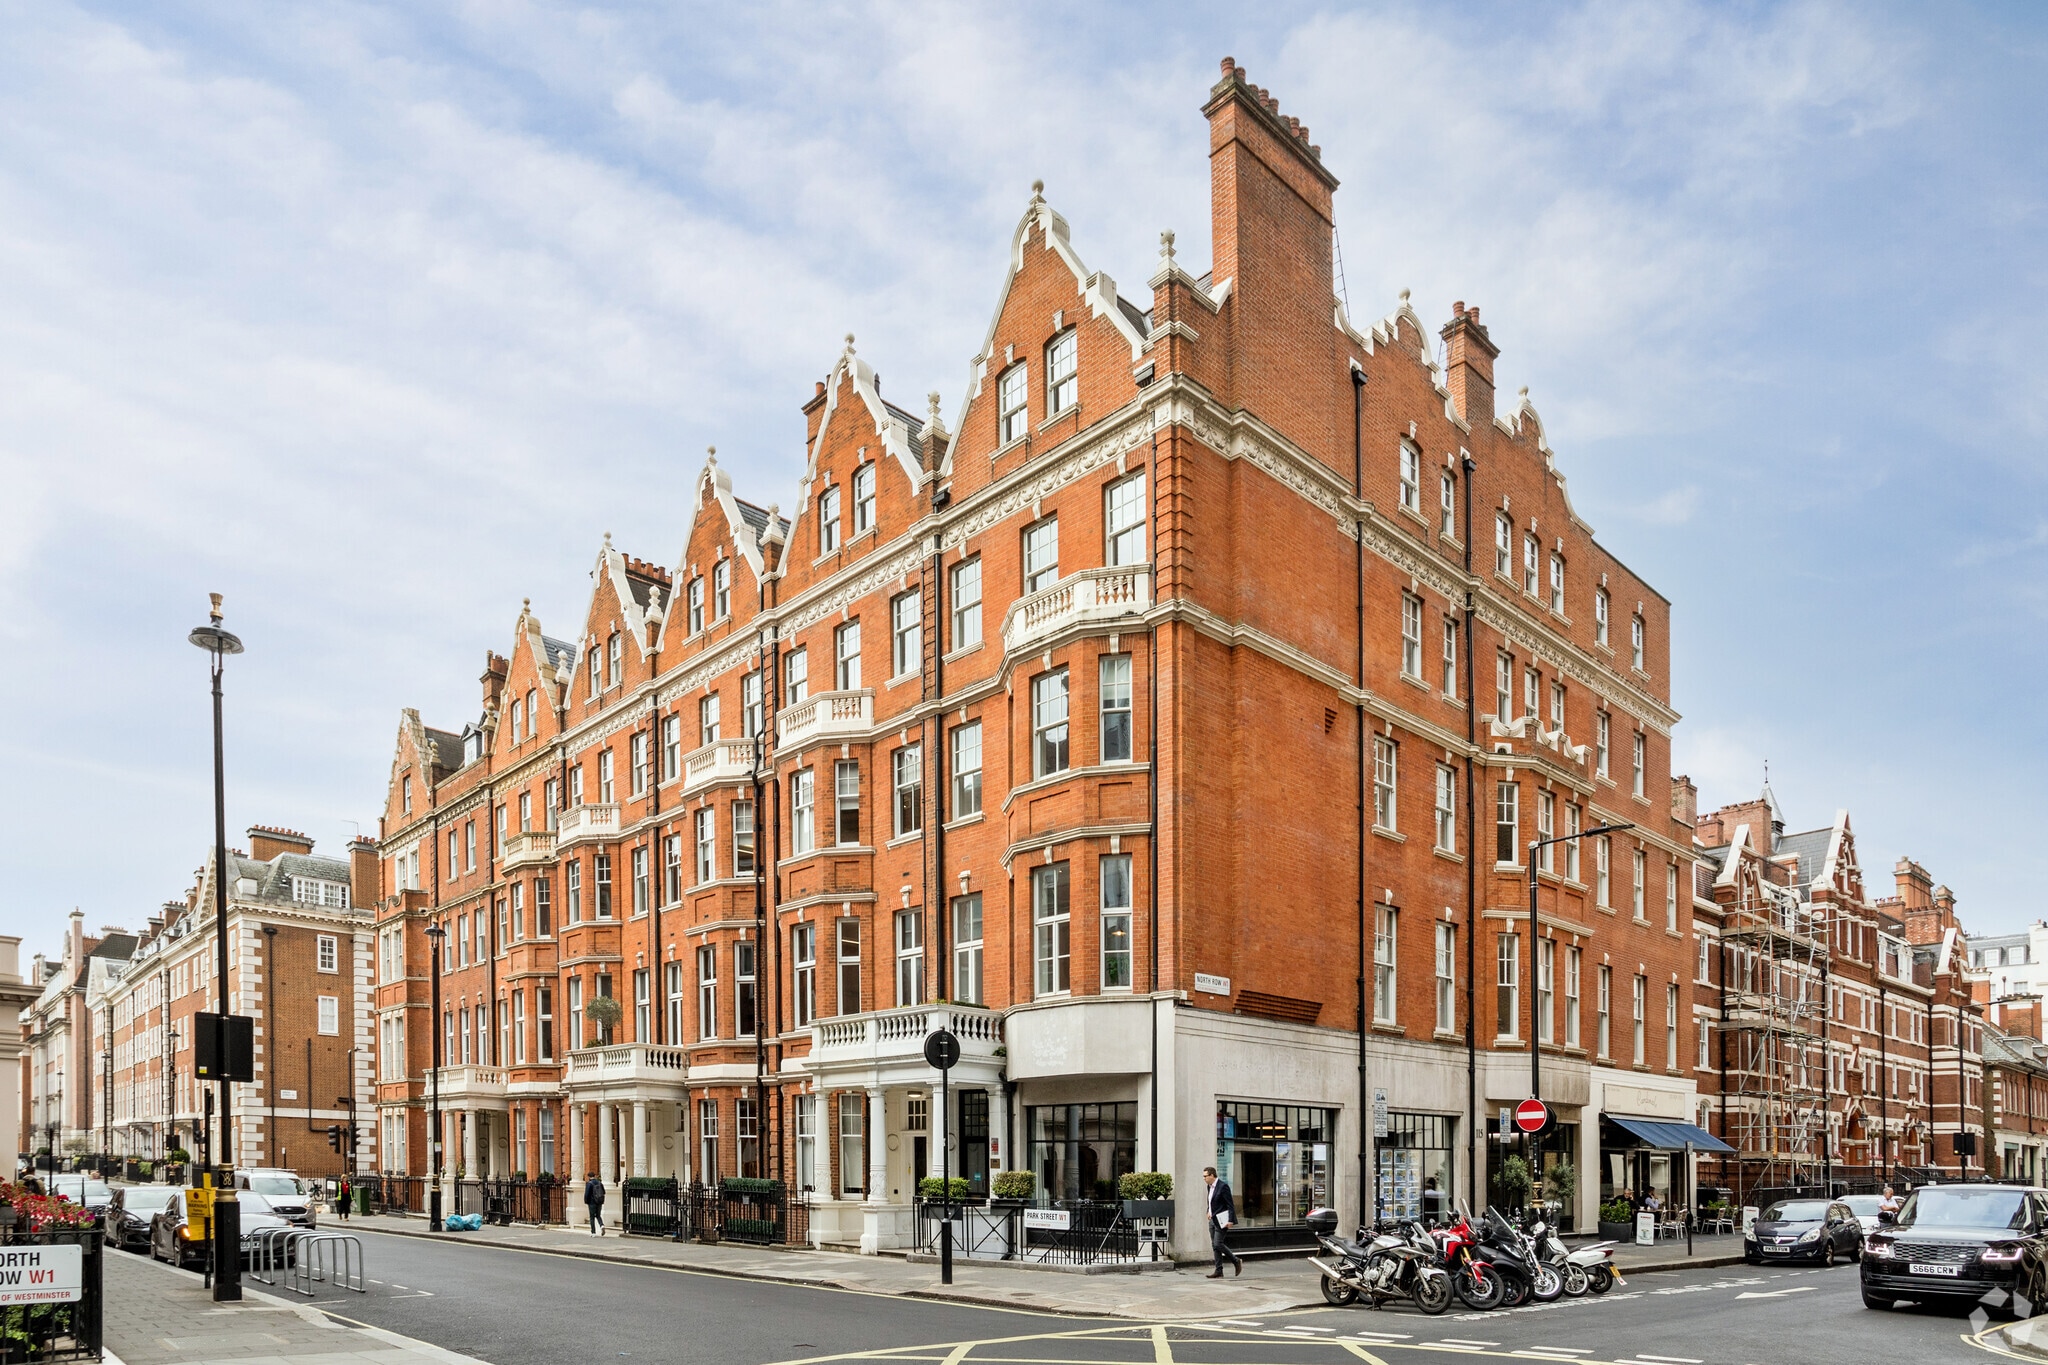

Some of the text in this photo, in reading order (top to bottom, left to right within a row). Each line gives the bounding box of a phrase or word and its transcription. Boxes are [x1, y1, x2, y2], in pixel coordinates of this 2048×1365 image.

[1197, 976, 1211, 985] NORTH
[1212, 978, 1221, 986] ROW
[1040, 1213, 1057, 1221] STREET
[1142, 1216, 1168, 1226] TO LET
[1913, 1265, 1935, 1273] S666
[29, 1269, 54, 1284] W1
[14, 1291, 71, 1300] WESTMINSTER
